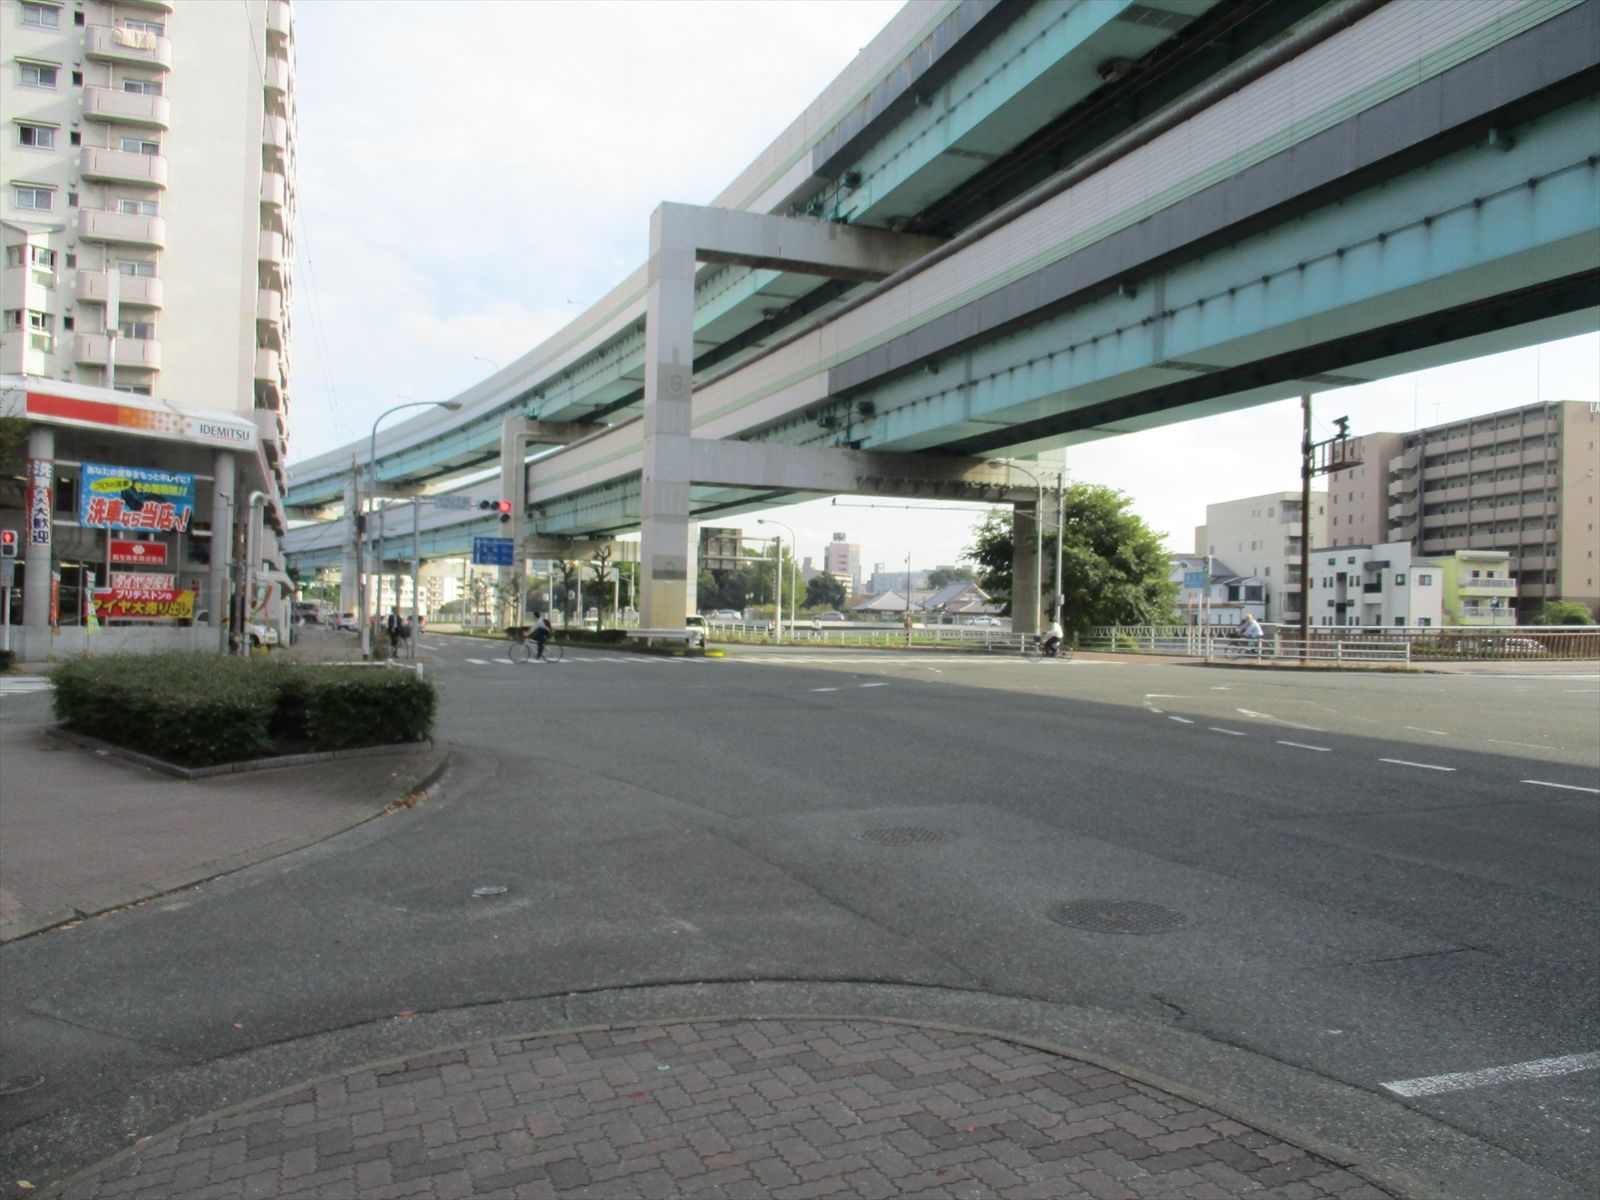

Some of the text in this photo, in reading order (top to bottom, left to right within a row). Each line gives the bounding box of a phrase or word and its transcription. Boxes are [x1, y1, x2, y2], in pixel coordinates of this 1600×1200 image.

[200, 423, 250, 441] IDEMITSU
[86, 497, 191, 532] 洗車なら当店へ!
